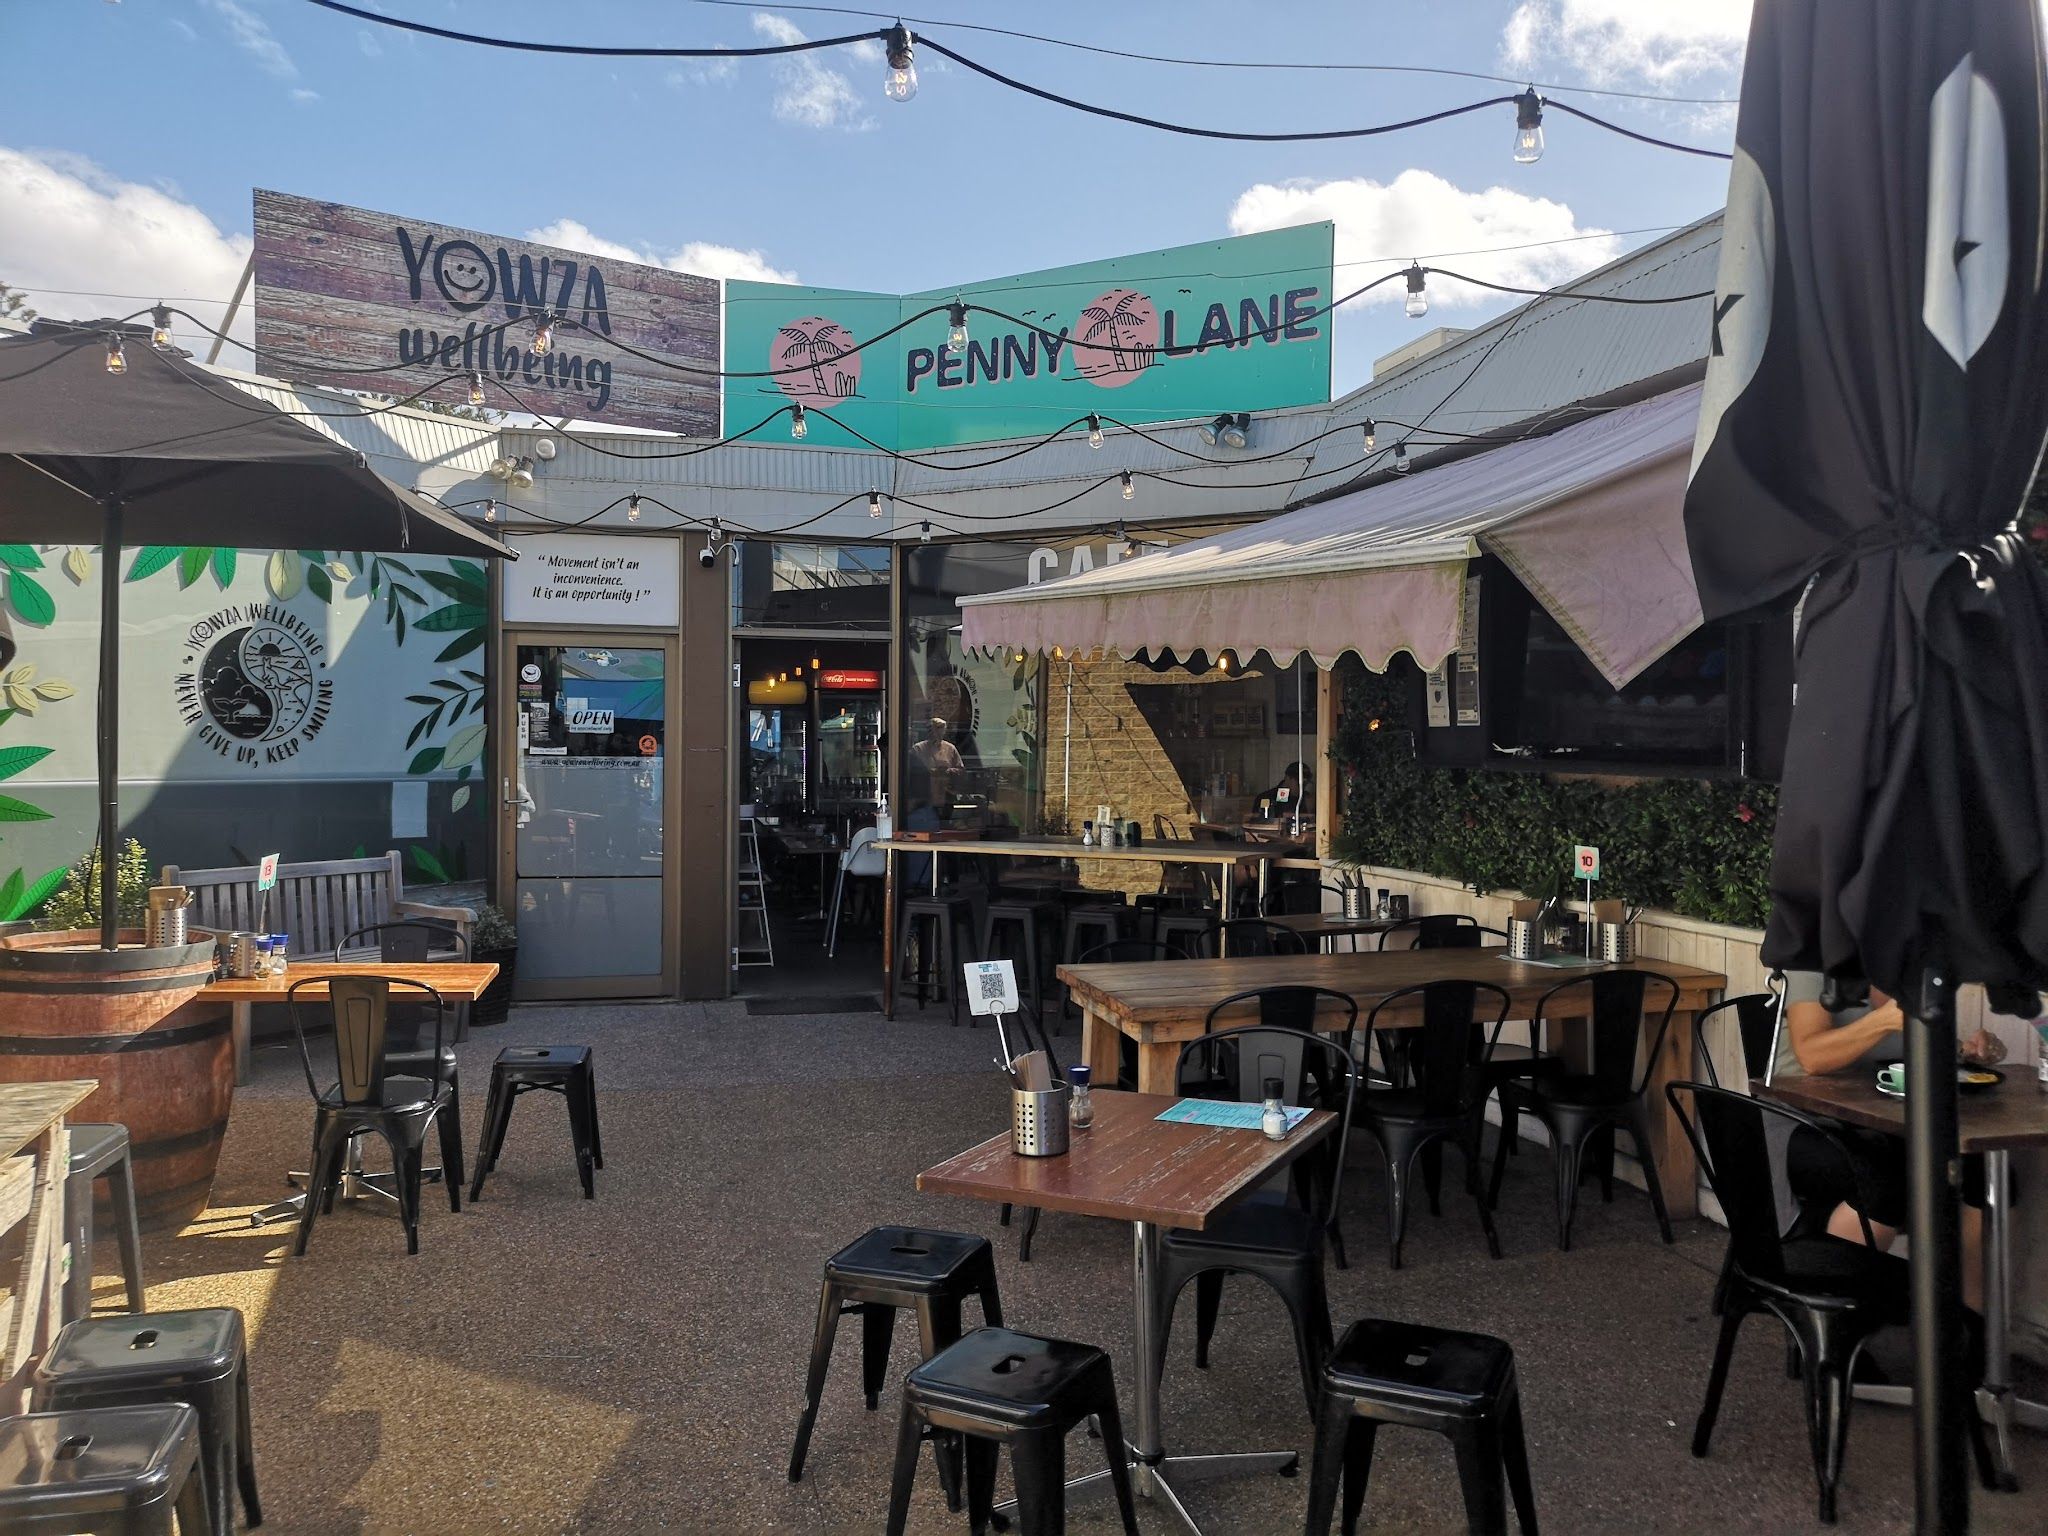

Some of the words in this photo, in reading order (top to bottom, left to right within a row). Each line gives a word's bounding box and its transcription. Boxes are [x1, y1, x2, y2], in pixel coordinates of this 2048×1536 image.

[397, 226, 612, 336] YOWZA
[906, 326, 1070, 393] PENNY
[1163, 286, 1319, 357] LANE
[399, 322, 612, 412] wellbeing
[553, 573, 623, 586] inconvenience.
[626, 561, 640, 570] an
[532, 586, 542, 598] It
[544, 587, 554, 599] is
[555, 590, 568, 599] an
[243, 602, 324, 657] WELLBEING
[174, 672, 203, 727] NEVER
[198, 724, 233, 757] GIVE
[236, 745, 260, 769] UP,
[266, 737, 300, 764] KEEP
[301, 678, 333, 742] SMILING
[572, 710, 612, 725] OPEN
[1581, 855, 1593, 867] 10
